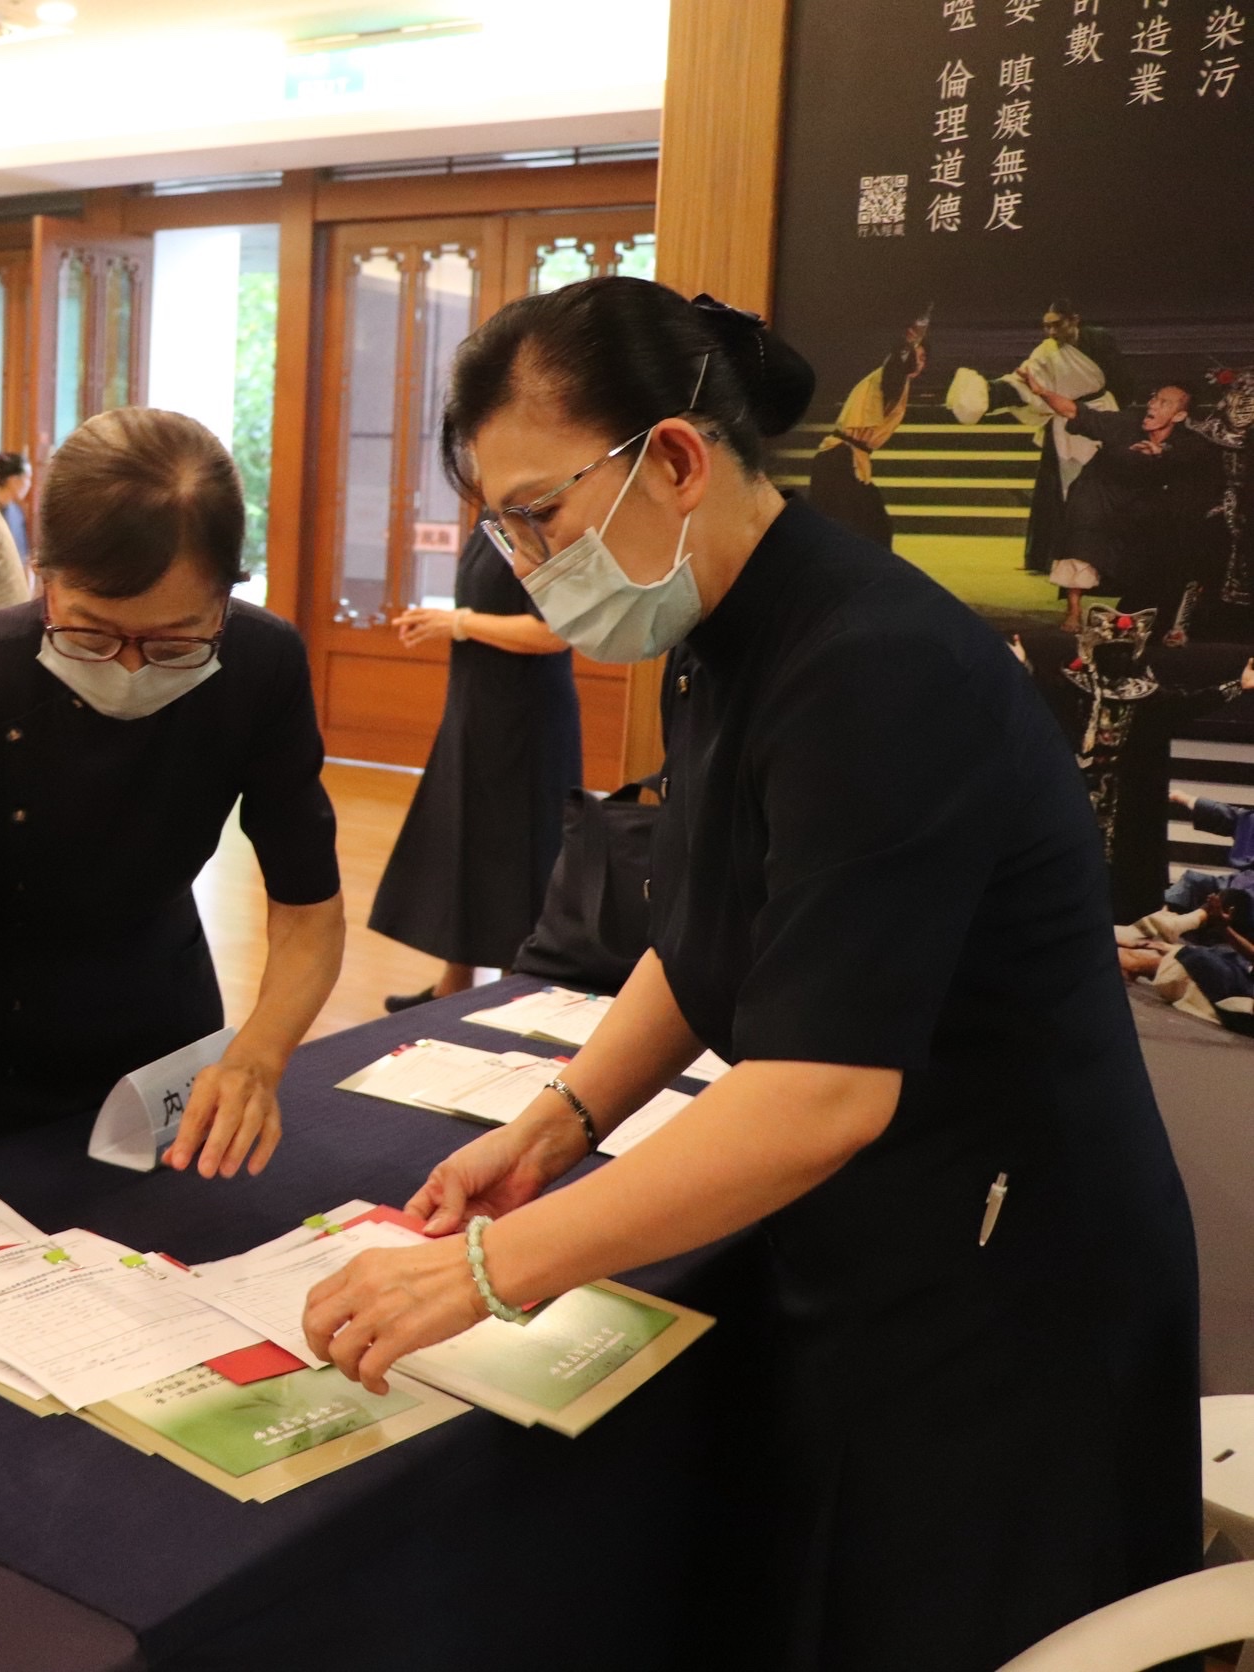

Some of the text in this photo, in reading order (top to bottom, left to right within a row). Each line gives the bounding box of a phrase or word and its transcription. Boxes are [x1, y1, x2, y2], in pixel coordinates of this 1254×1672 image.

[1126, 0, 1172, 105] 造業
[1196, 5, 1245, 98] 染污
[925, 58, 975, 233] 倫理道德
[984, 53, 1035, 231] 瞋癡無度
